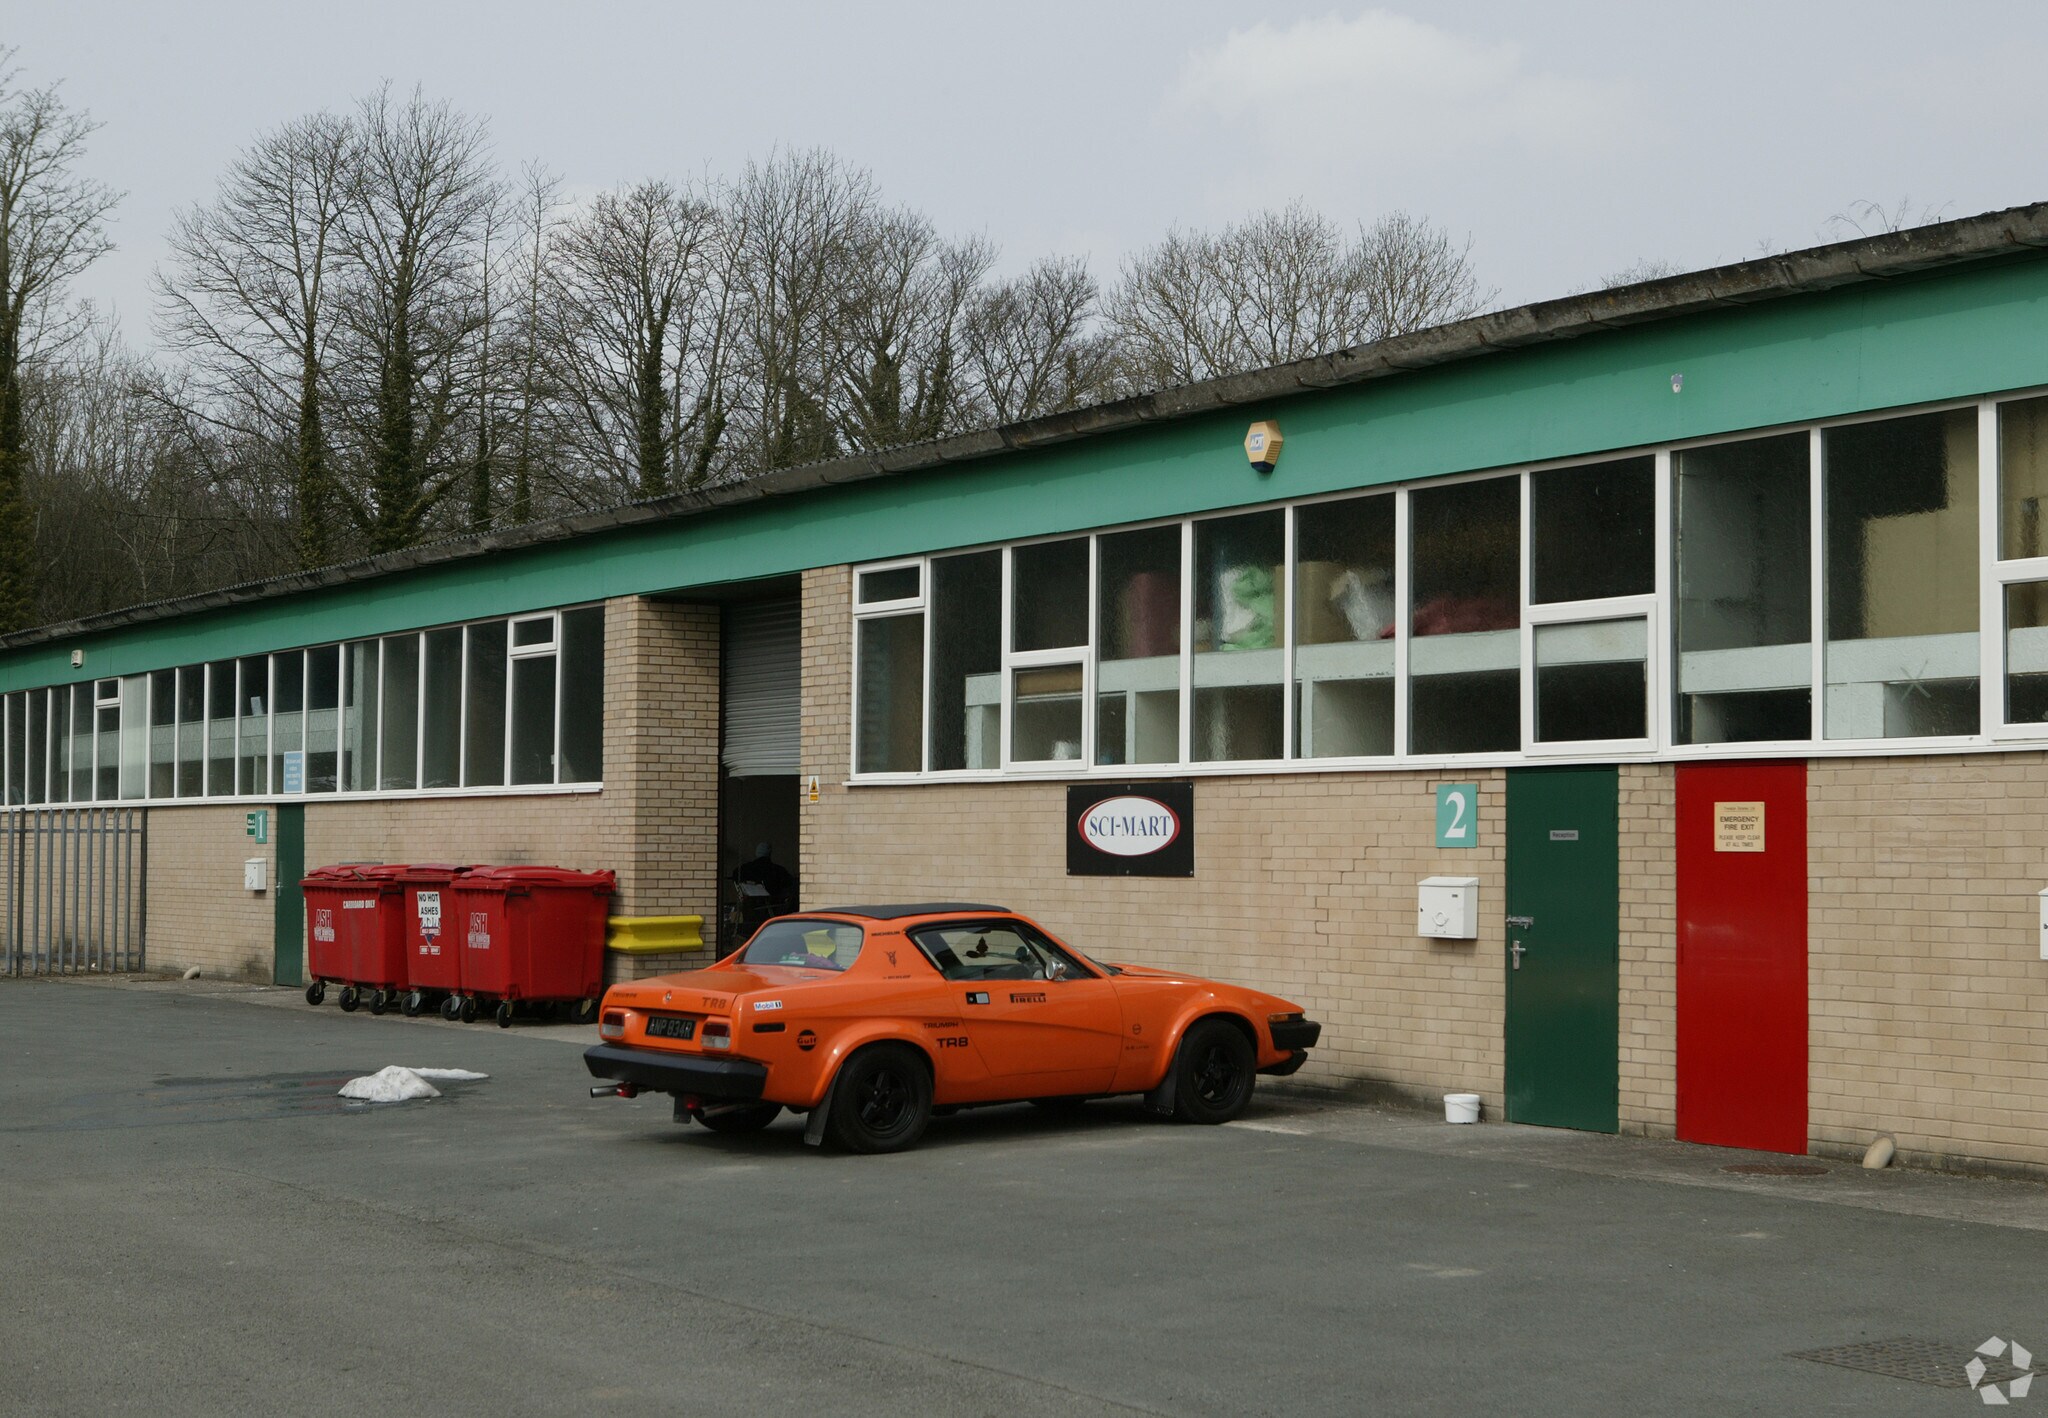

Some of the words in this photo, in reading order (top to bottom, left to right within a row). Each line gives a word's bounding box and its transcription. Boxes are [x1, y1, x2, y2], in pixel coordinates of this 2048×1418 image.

[1445, 792, 1466, 838] 2
[258, 814, 264, 838] 1
[1090, 816, 1170, 836] SCI-MART
[1552, 831, 1576, 839] Reception
[418, 893, 427, 902] NO
[427, 893, 438, 902] HOT
[420, 907, 439, 915] ASHES
[316, 909, 332, 927] ASH
[470, 912, 488, 933] ASH
[702, 997, 727, 1009] TR8
[1010, 993, 1046, 1003] PIRELLI
[755, 1002, 774, 1010] Mobil
[648, 1017, 667, 1035] ANP
[668, 1020, 692, 1038] 834R
[797, 1036, 816, 1045] Gulf
[936, 1037, 969, 1048] TR8
